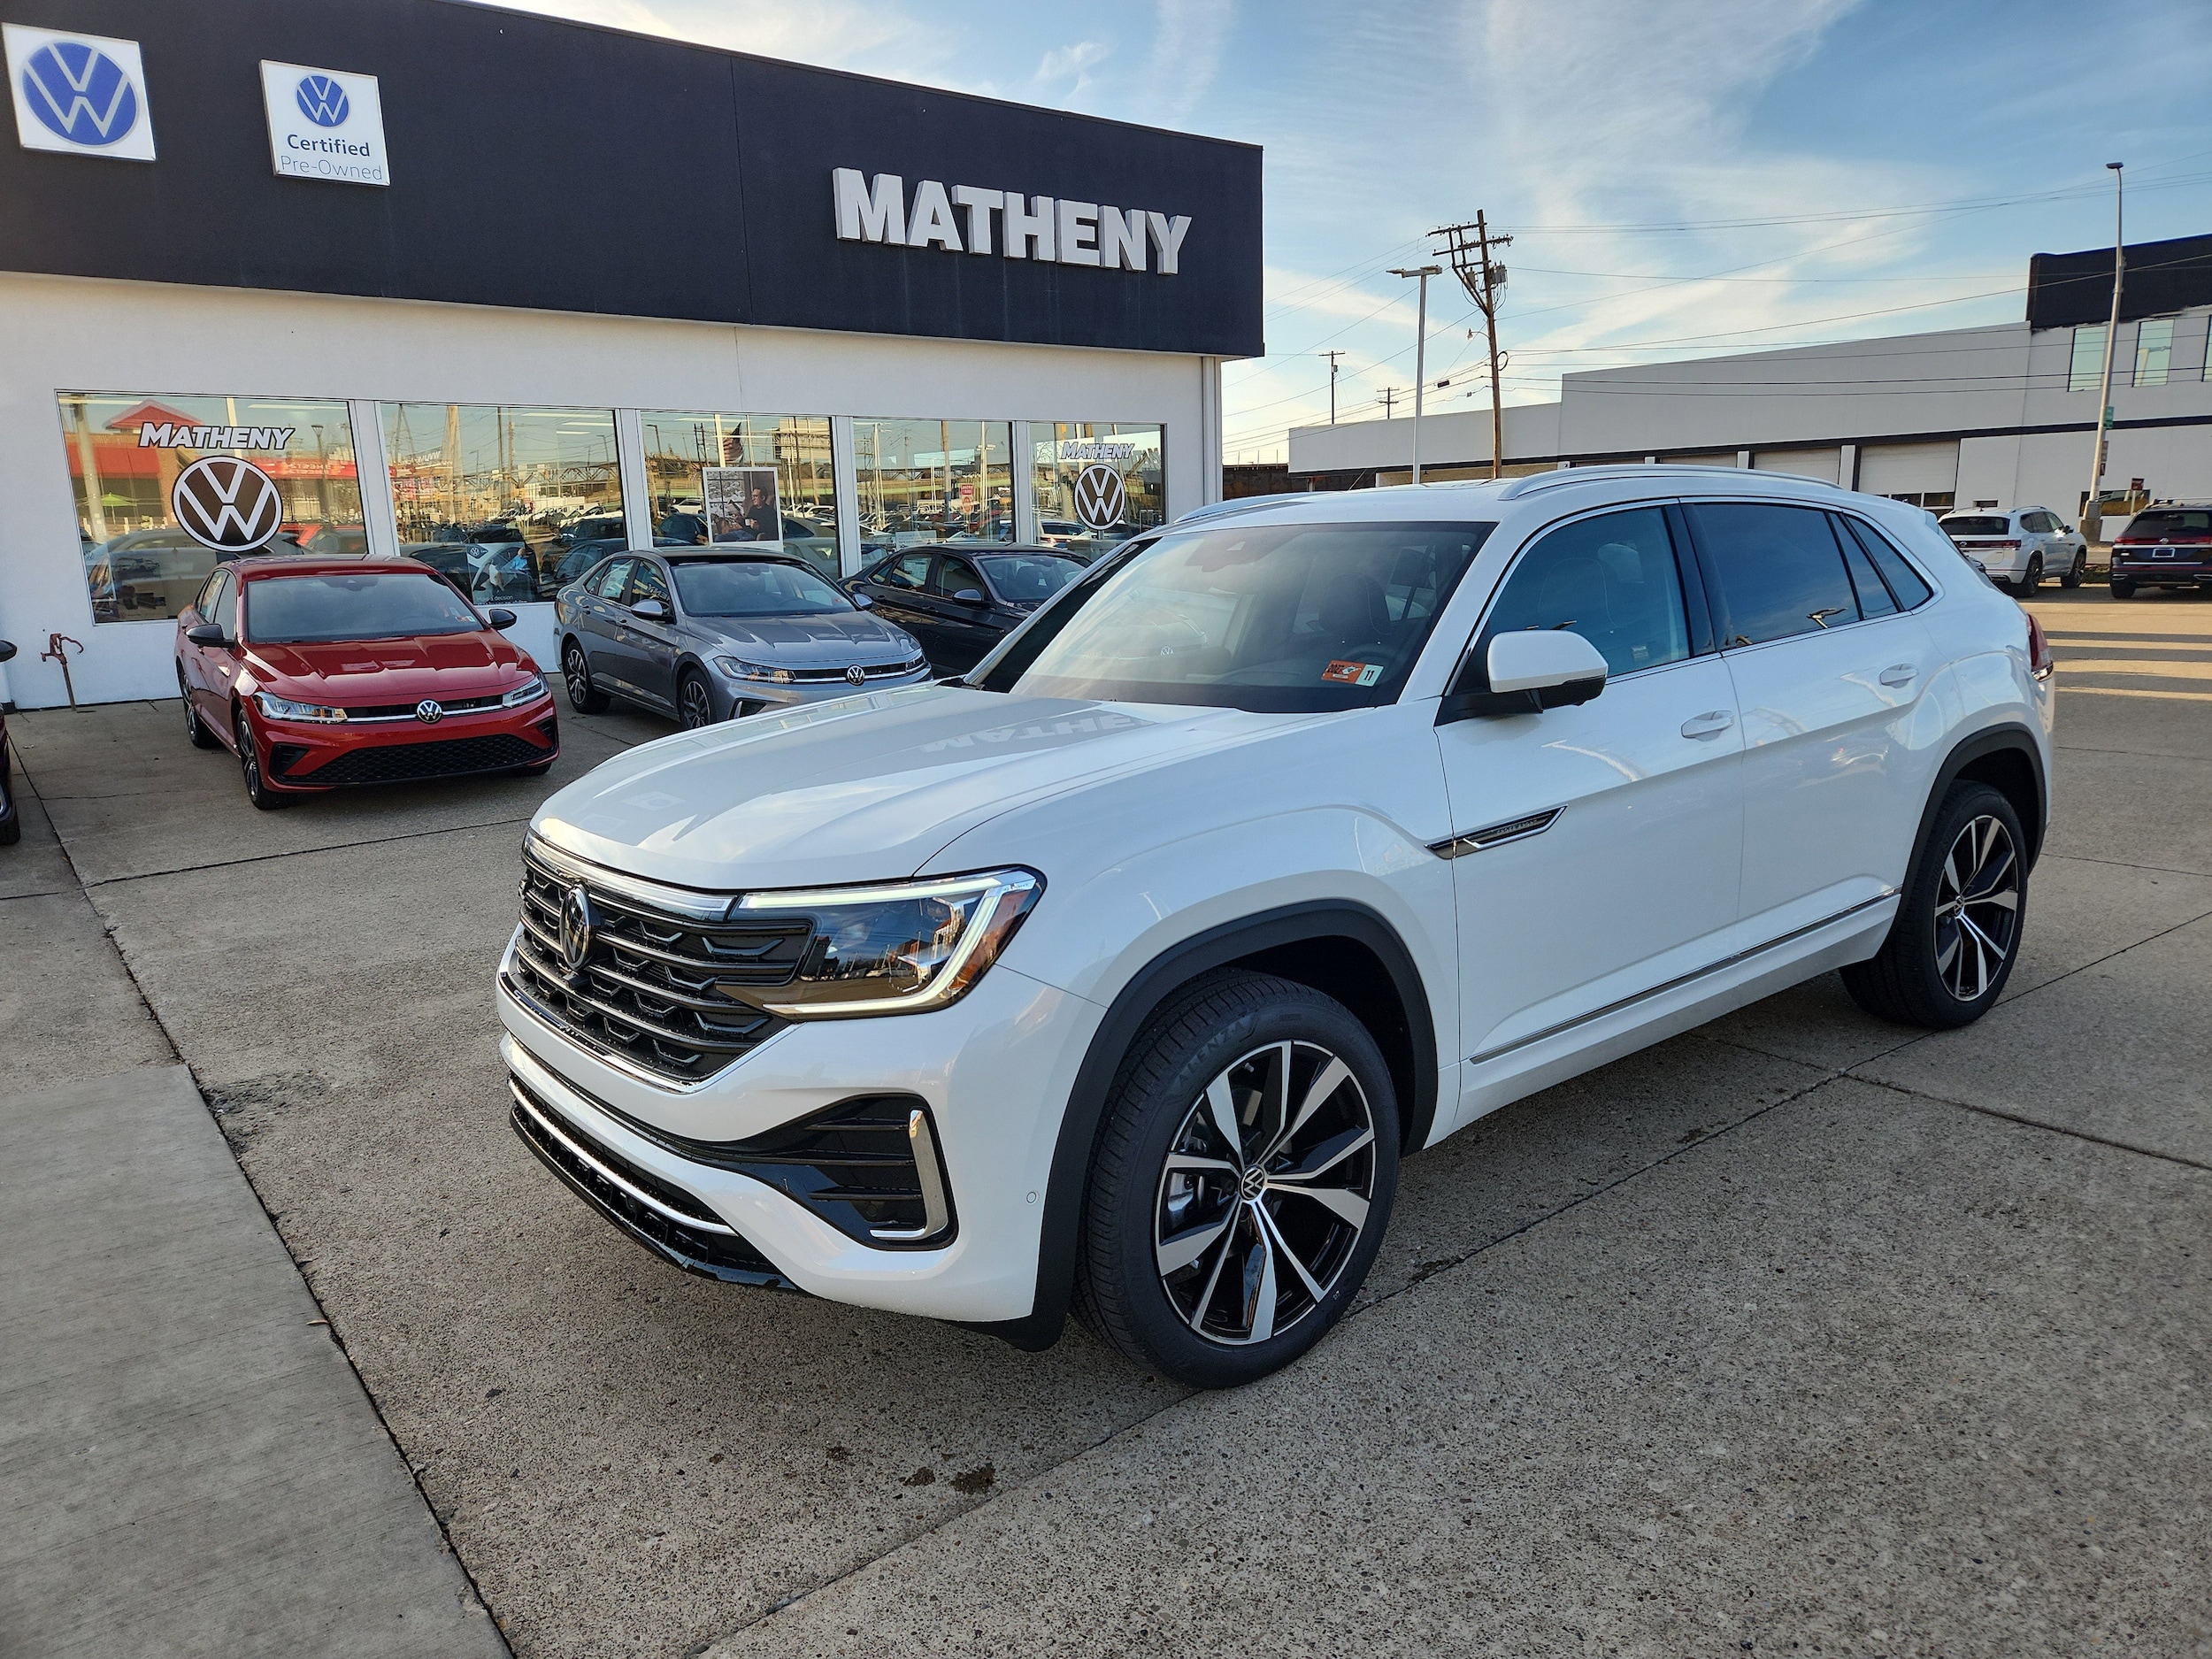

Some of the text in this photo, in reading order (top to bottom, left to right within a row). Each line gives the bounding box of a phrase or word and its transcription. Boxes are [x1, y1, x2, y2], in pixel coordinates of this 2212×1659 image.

[287, 134, 371, 157] Certified
[280, 155, 383, 180] Pre-Owned
[833, 166, 1192, 275] MATHENY
[138, 421, 296, 449] MATHENY
[1061, 442, 1135, 460] MATHENY
[1363, 669, 1376, 681] 11
